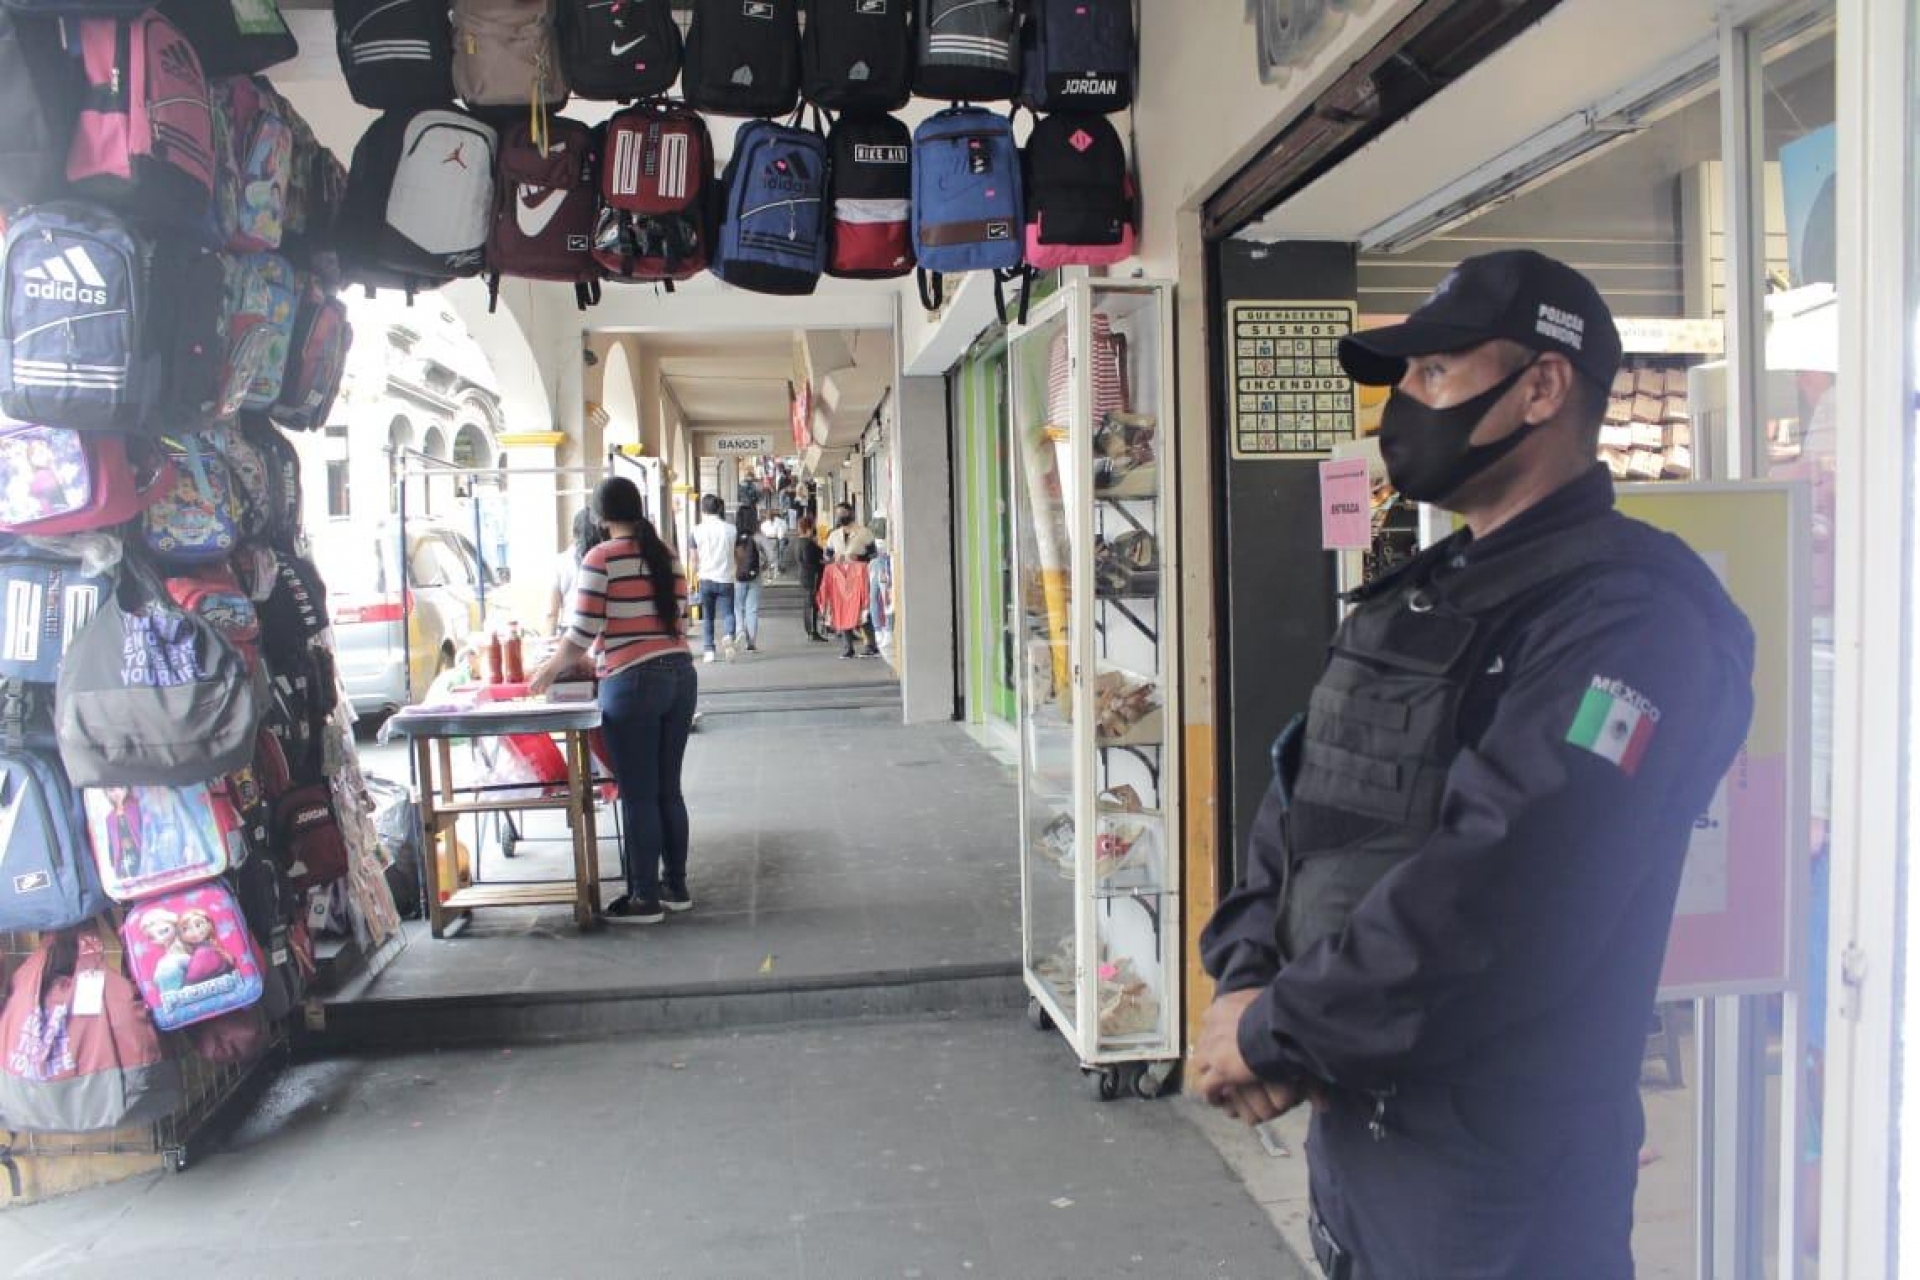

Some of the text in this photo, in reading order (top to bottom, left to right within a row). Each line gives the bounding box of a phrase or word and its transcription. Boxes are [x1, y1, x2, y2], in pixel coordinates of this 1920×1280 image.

[1061, 79, 1117, 95] JORDAN
[857, 148, 883, 161] NIKE
[25, 280, 107, 305] adidas
[1252, 325, 1335, 335] SISMOS
[1246, 380, 1345, 389] INCENDIOS
[120, 667, 171, 687] YOUR
